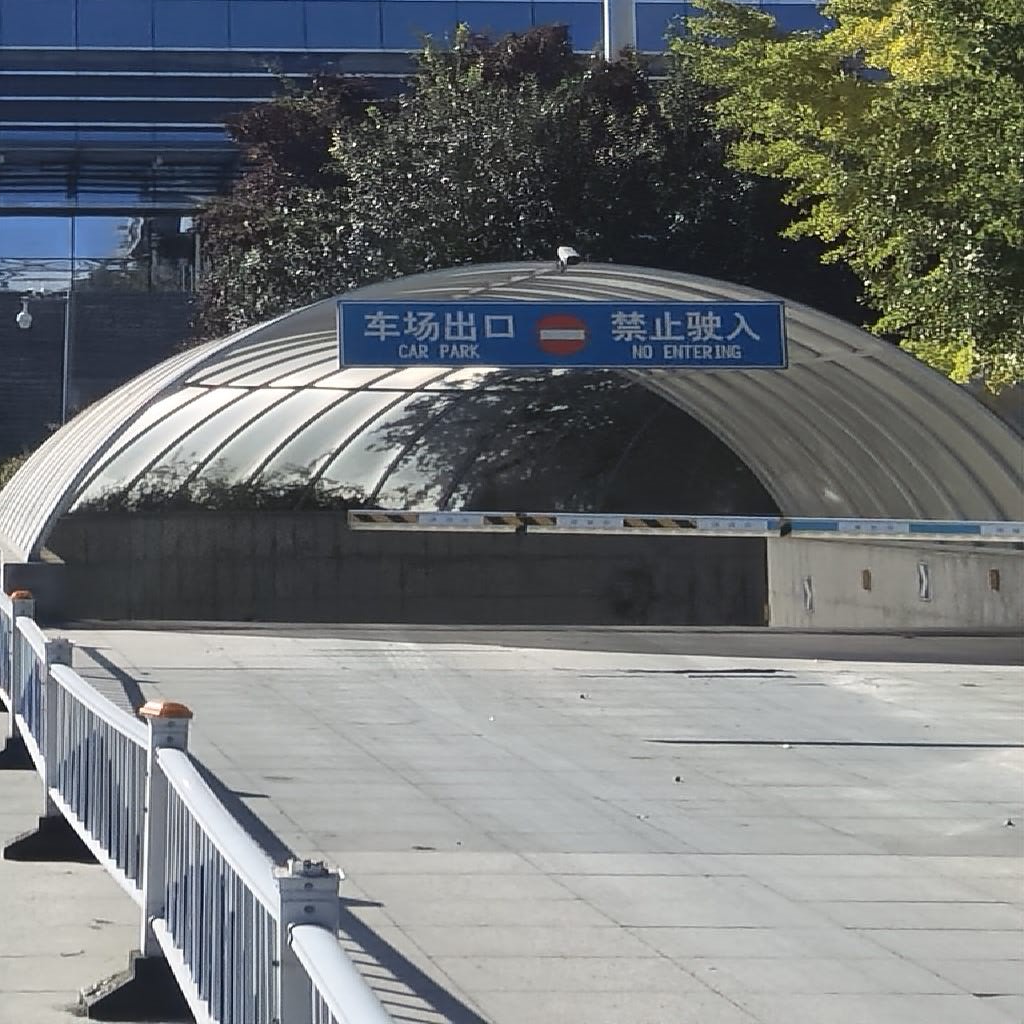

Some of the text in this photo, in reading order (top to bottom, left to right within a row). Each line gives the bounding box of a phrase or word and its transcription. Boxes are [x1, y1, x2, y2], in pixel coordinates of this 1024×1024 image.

[364, 310, 514, 342] 车场出口
[611, 310, 760, 342] 禁止驶入
[399, 344, 480, 359] CAR PARK
[632, 344, 741, 360] NO ENTERING
